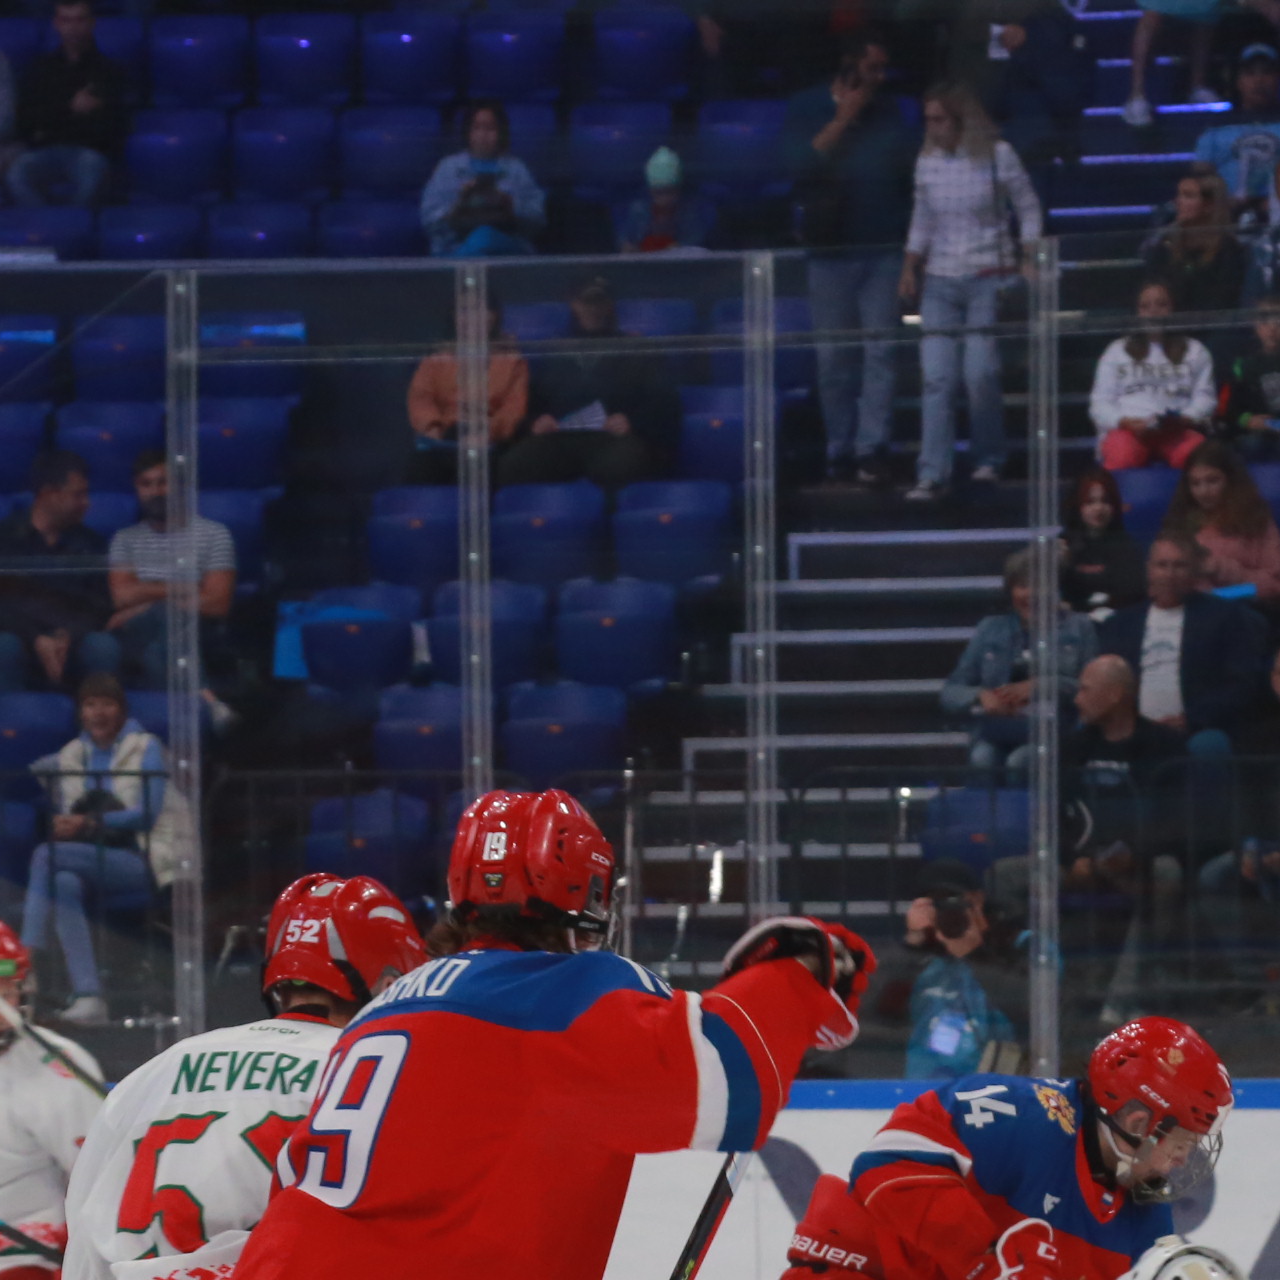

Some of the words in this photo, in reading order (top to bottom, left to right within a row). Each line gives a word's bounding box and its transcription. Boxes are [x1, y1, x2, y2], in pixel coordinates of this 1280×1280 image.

[482, 831, 507, 860] 19
[286, 919, 320, 943] 52
[249, 1024, 302, 1036] LUTCH
[171, 1050, 320, 1095] NEVERA
[954, 1084, 1017, 1128] 14
[1139, 1084, 1170, 1108] CCM
